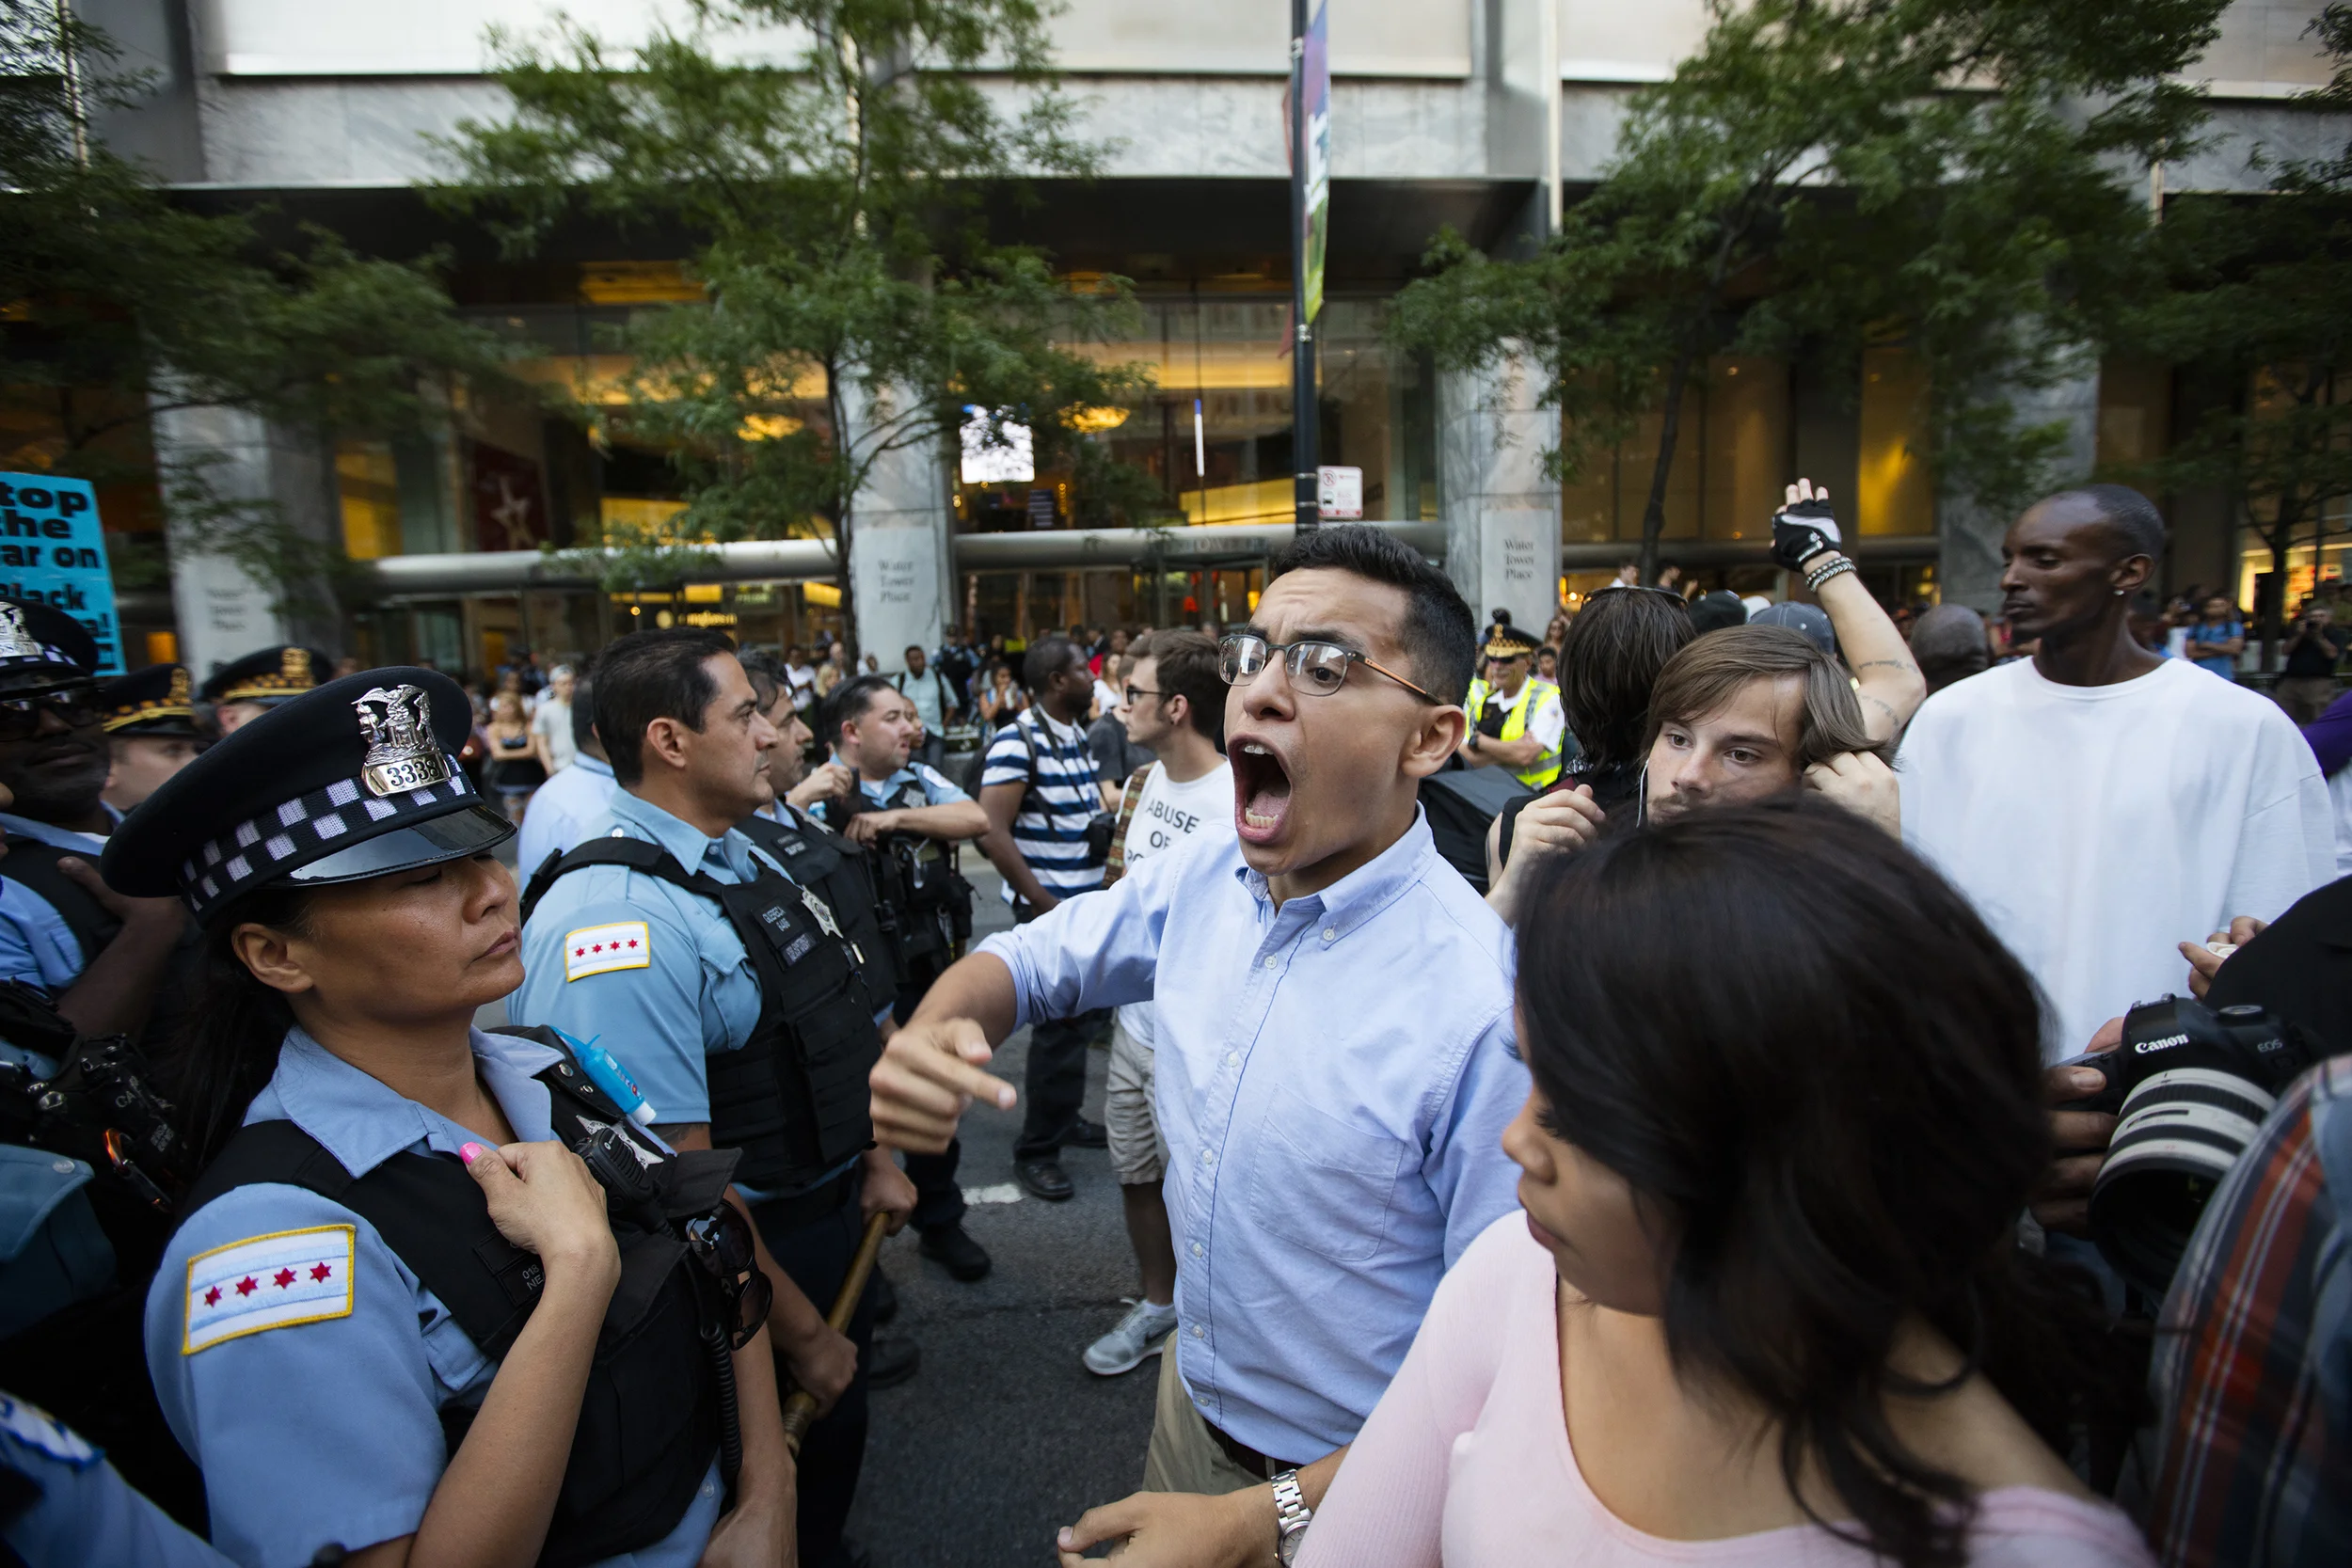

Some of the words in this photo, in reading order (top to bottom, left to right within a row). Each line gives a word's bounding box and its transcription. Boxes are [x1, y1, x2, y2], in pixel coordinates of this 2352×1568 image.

[0, 509, 72, 539] he
[1504, 539, 1534, 551] Water
[54, 546, 100, 569] on
[1504, 554, 1534, 565] Tower
[1505, 568, 1534, 580] Place
[387, 760, 439, 787] 3338
[1146, 799, 1200, 833] ABUSE
[1150, 831, 1171, 850] OF
[2135, 1034, 2189, 1054] Canon
[2257, 1038, 2283, 1053] EOS
[522, 1264, 540, 1280] 018
